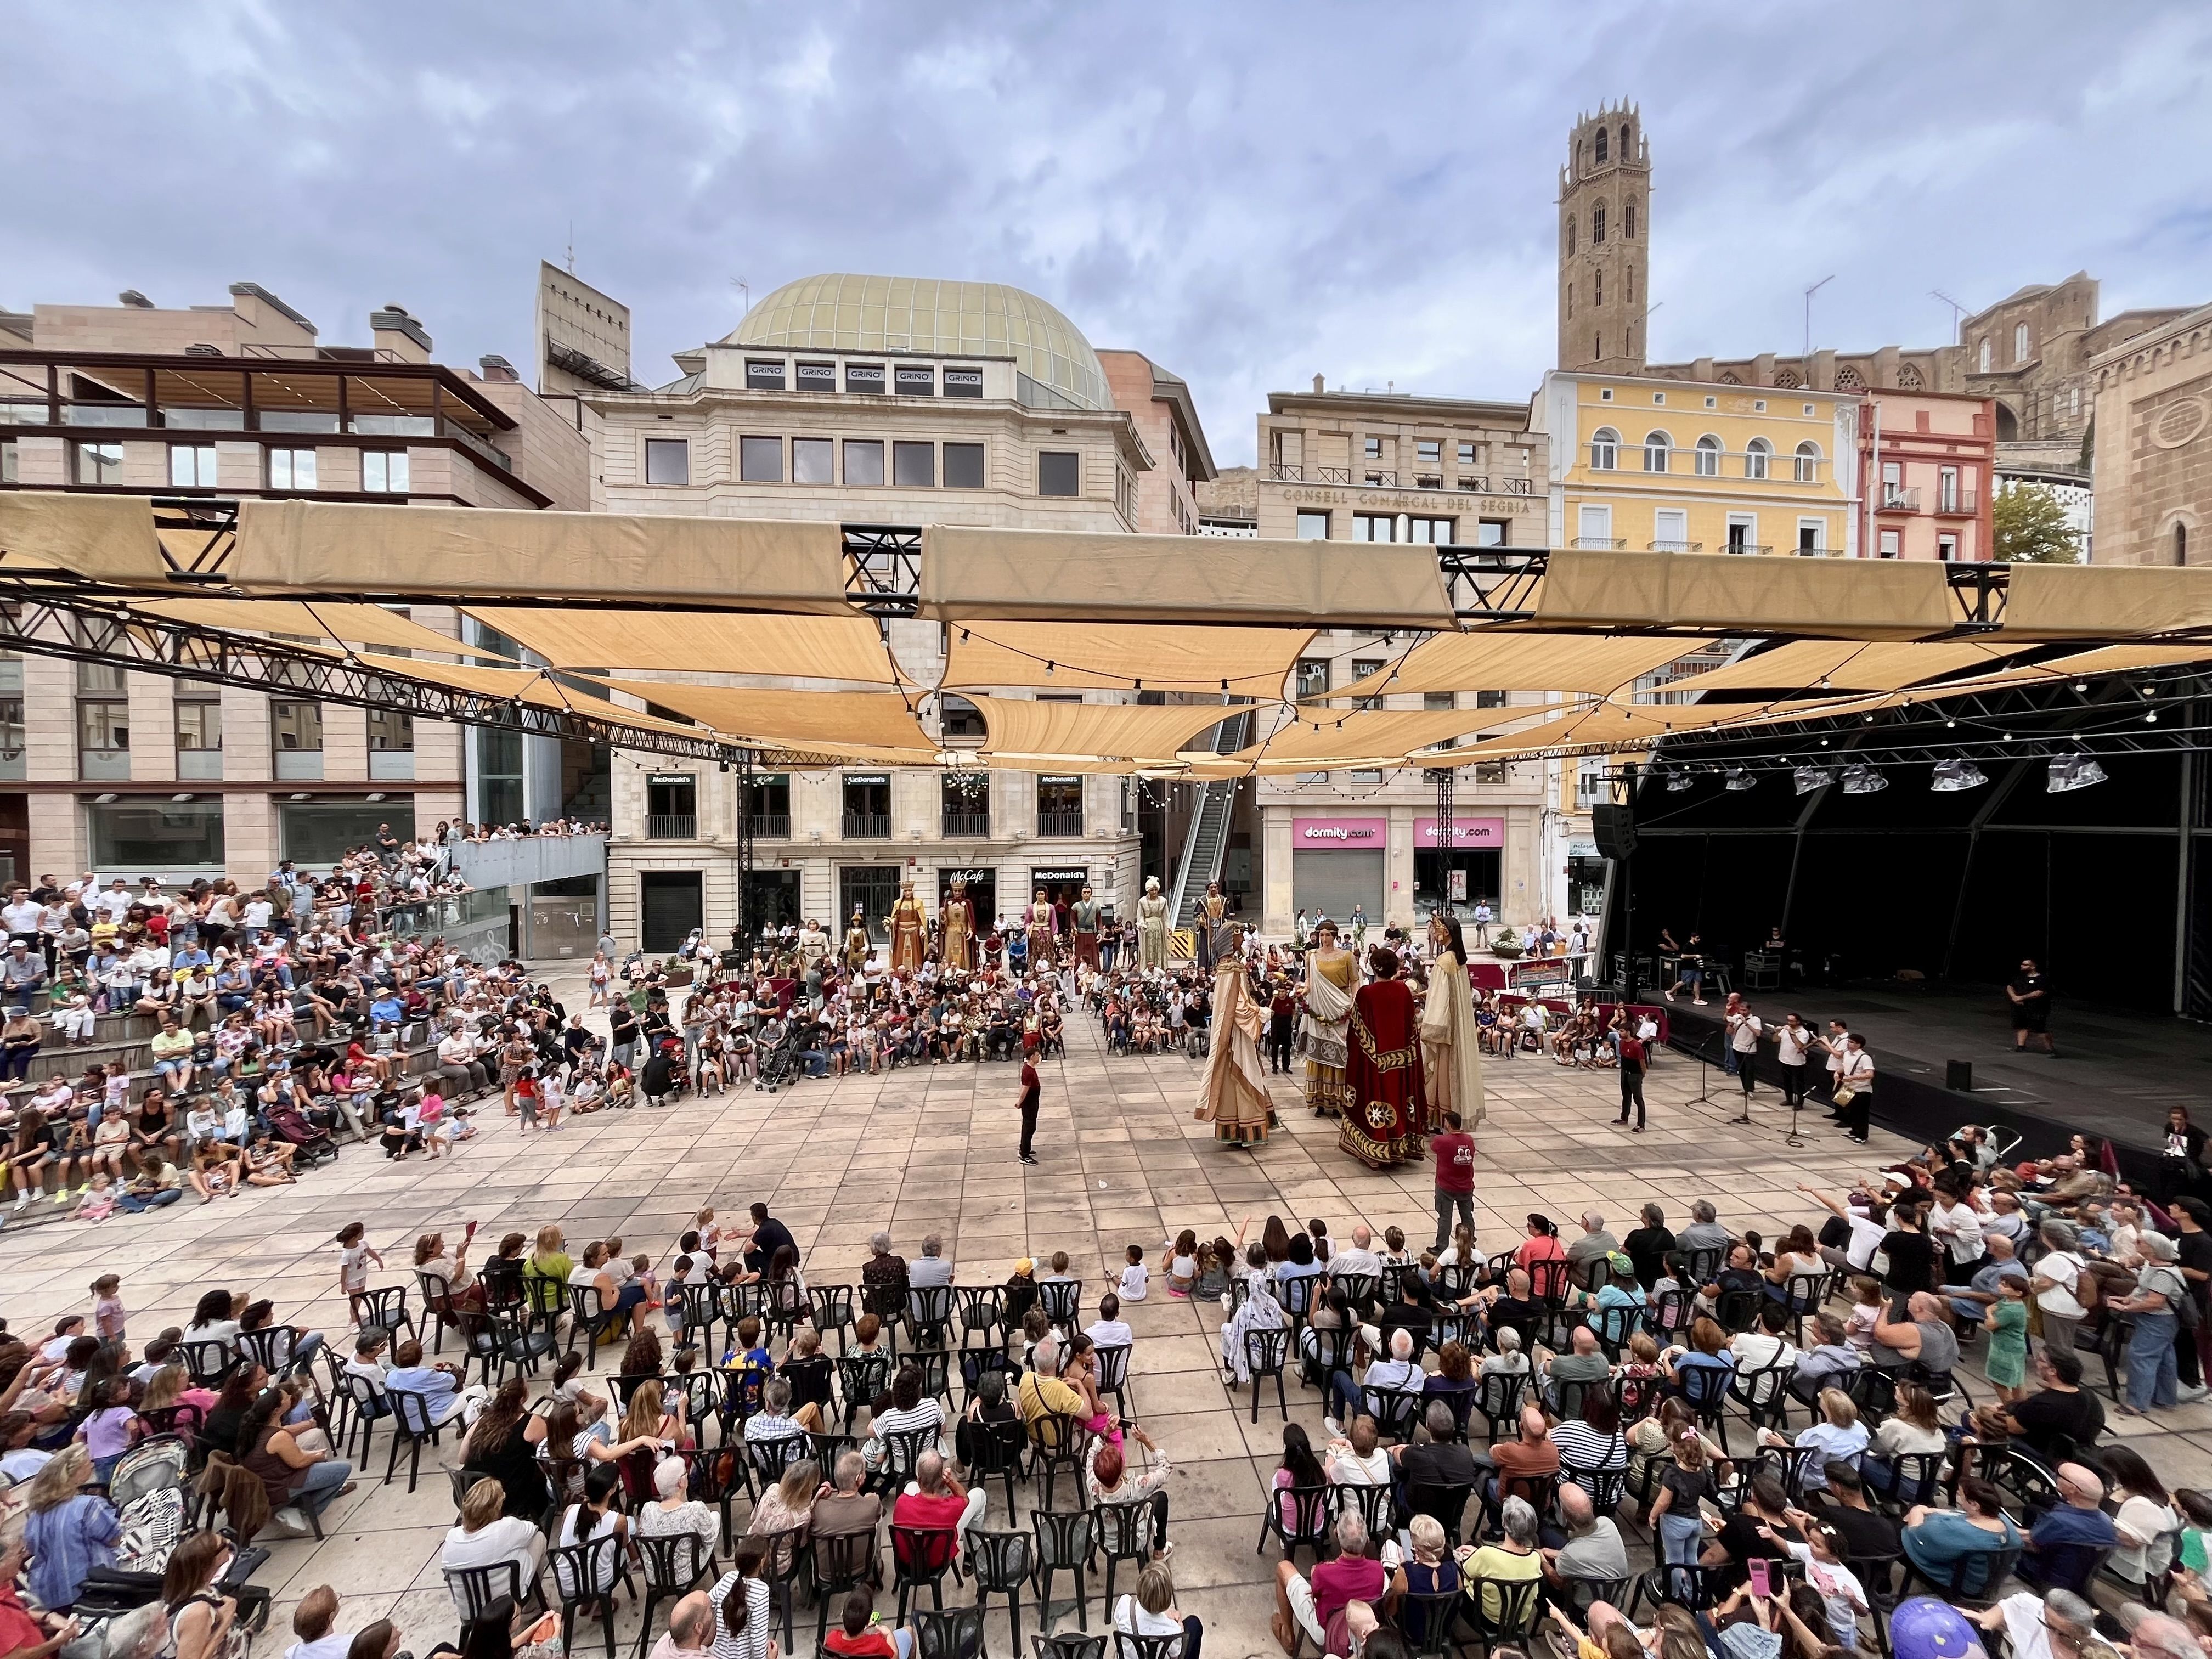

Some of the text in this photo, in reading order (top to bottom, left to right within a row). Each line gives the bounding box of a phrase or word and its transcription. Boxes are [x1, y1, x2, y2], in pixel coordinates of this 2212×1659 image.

[1283, 489, 1348, 504] CONSELL
[1447, 498, 1472, 510] DEL
[1481, 499, 1530, 514] SEGRIÀ
[1305, 826, 1373, 840] dormity.com
[1035, 871, 1085, 879] McDonald's
